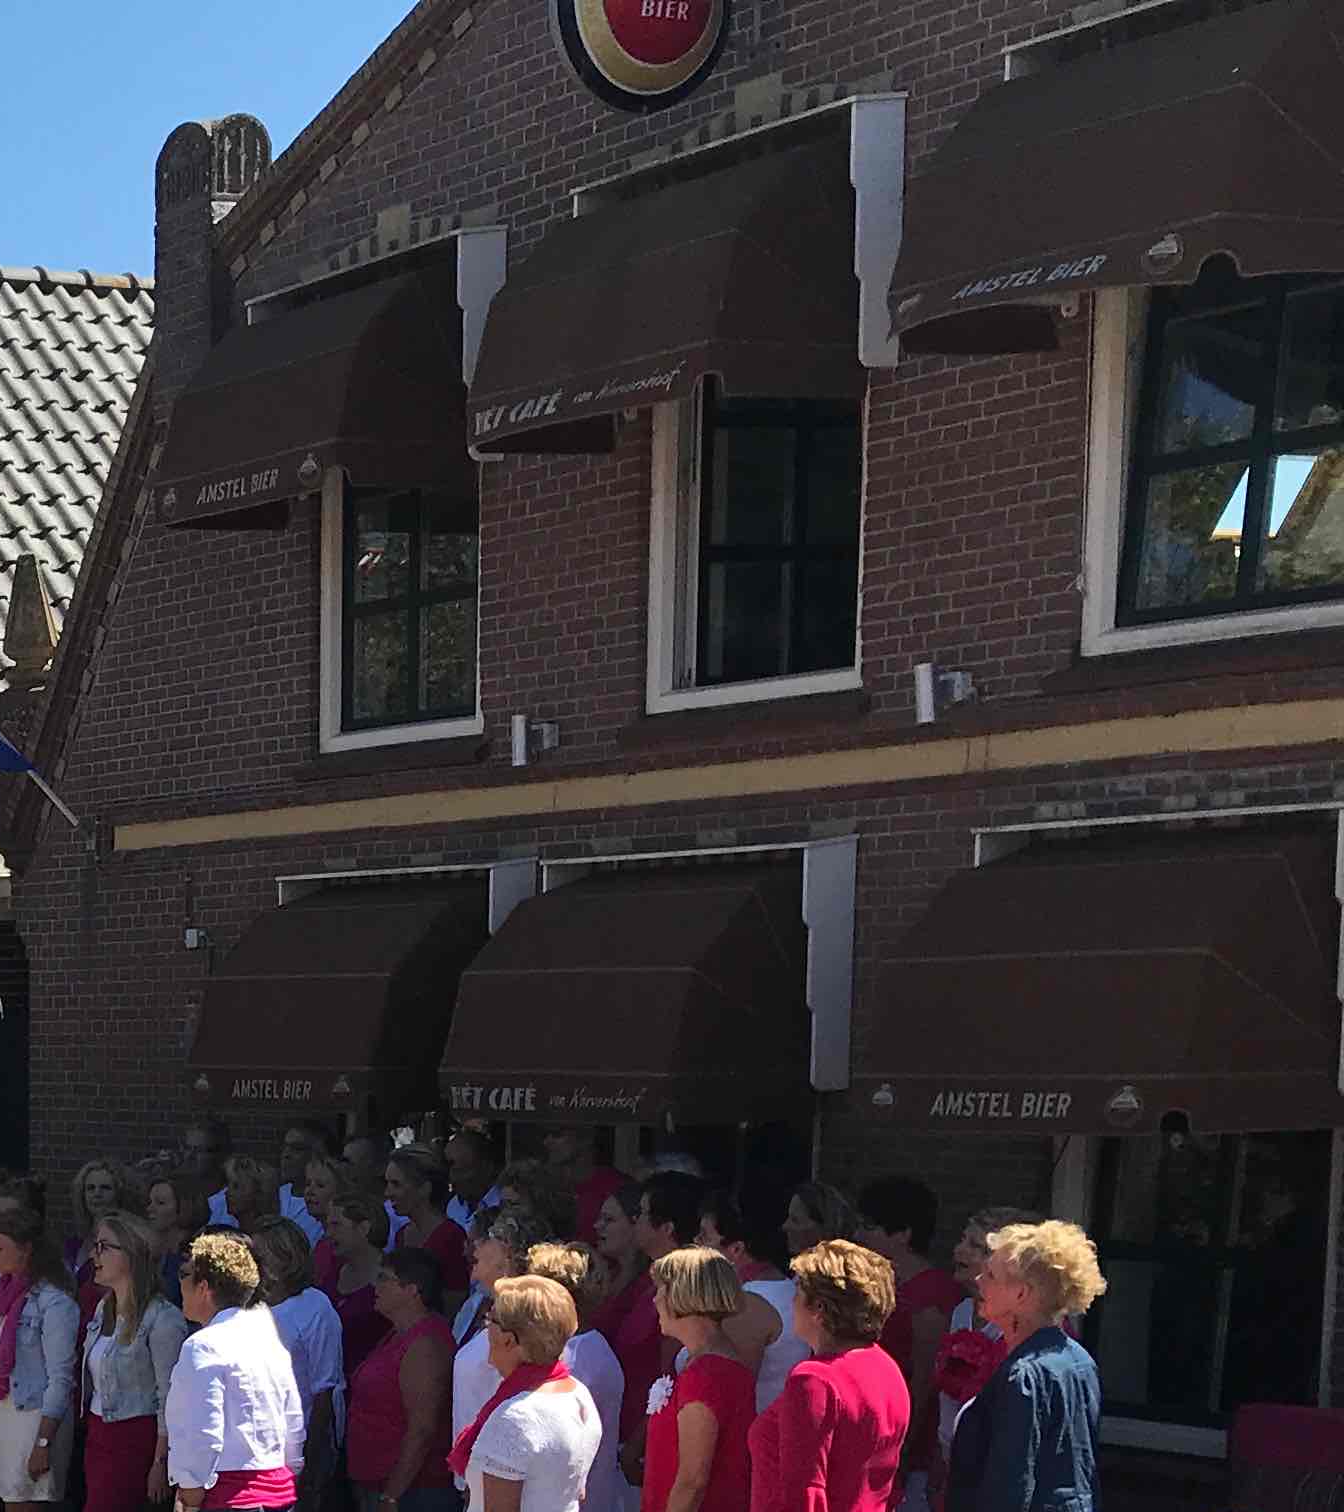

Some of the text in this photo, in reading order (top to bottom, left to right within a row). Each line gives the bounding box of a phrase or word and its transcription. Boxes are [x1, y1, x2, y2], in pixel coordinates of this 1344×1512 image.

[641, 0, 689, 20] BIER
[951, 254, 1106, 301] AMSTEL BIER
[197, 468, 279, 505] AMSTEL BIER
[231, 1079, 312, 1100] AMSTEL BIER
[489, 1081, 537, 1111] CAFÉ
[930, 1091, 1072, 1118] AMSTEL BIER
